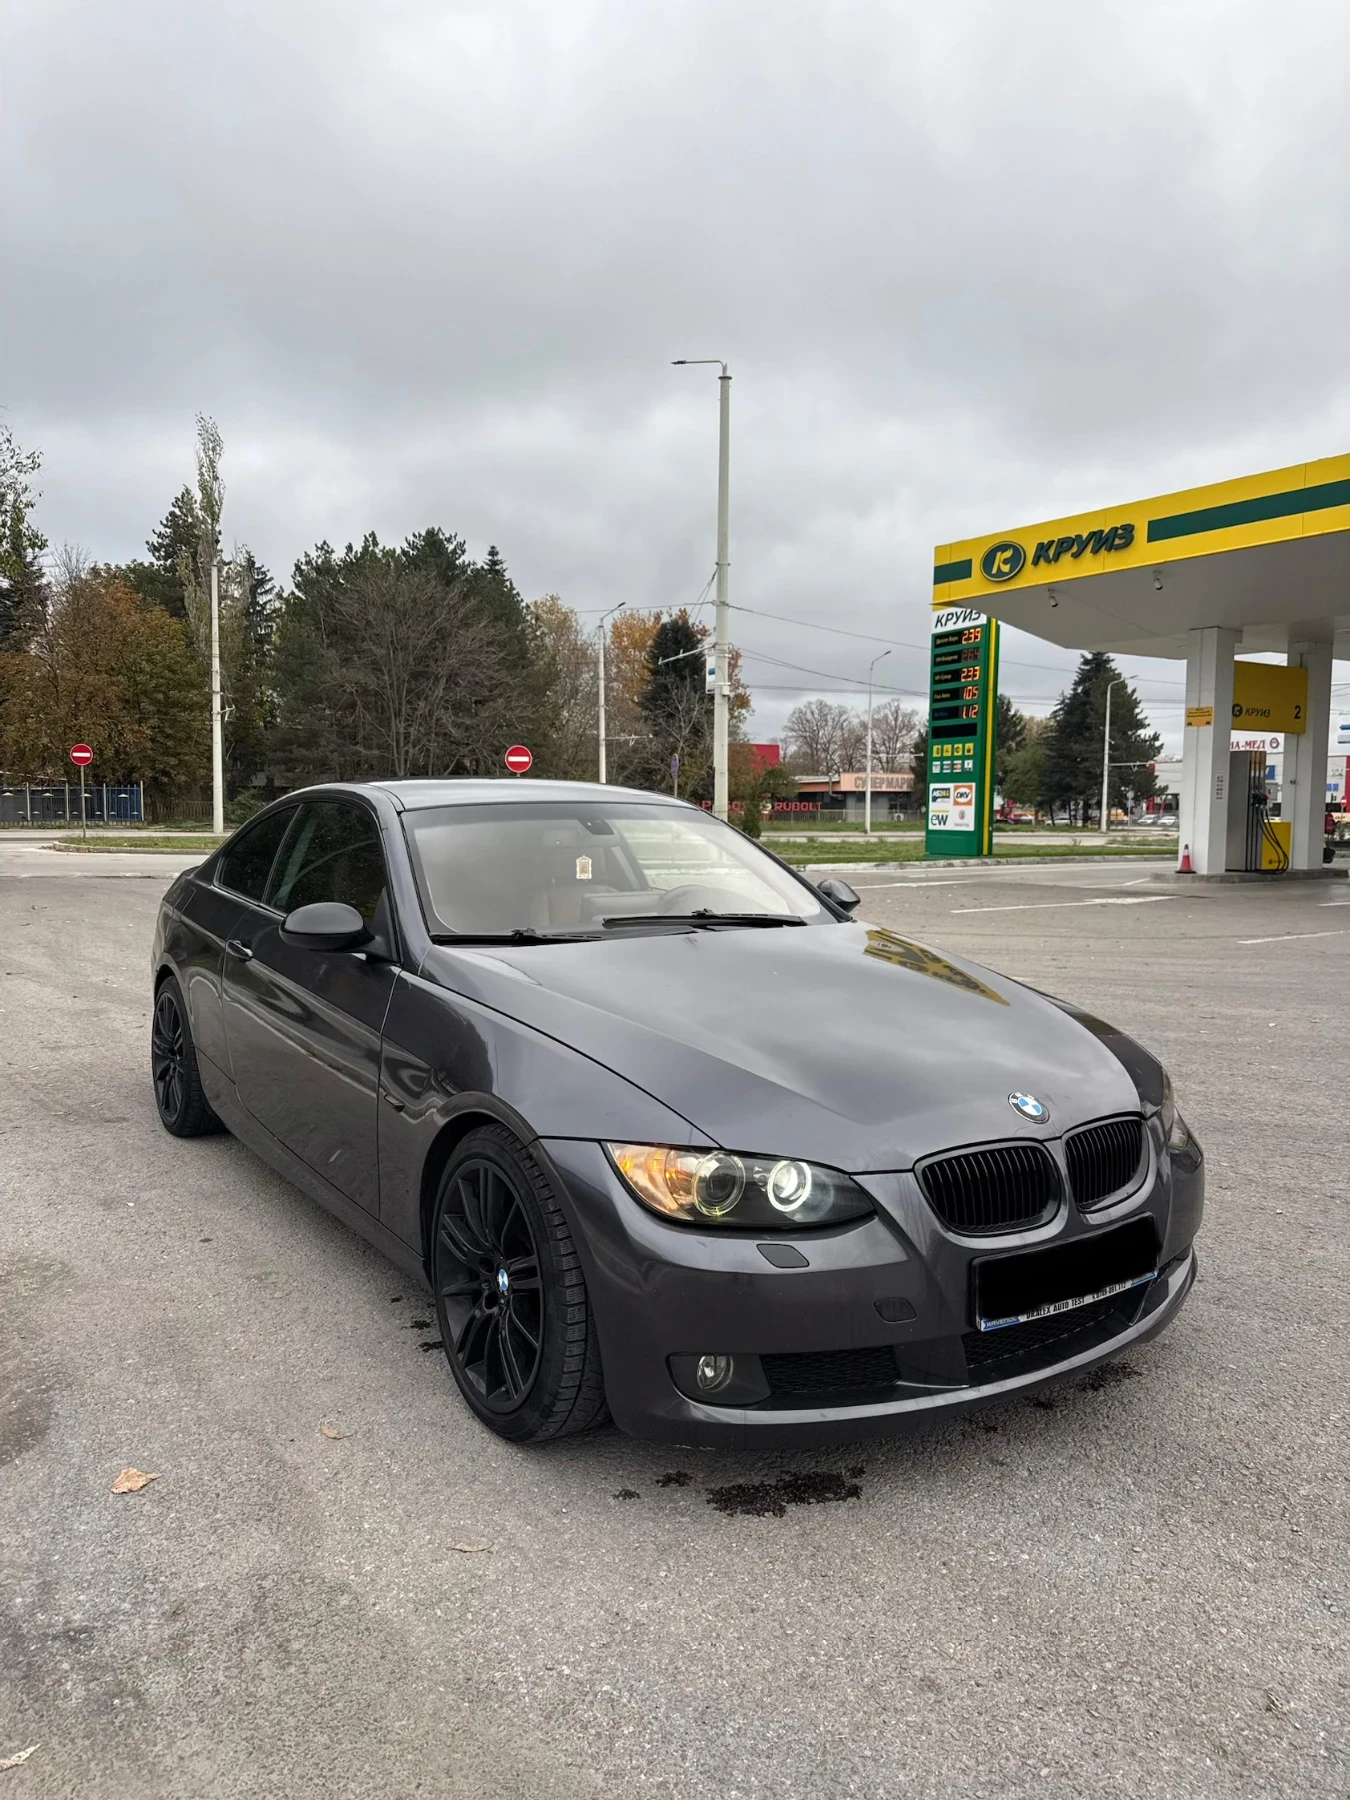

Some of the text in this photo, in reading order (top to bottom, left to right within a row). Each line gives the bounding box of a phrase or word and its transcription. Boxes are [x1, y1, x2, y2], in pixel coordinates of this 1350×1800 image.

[1031, 523, 1135, 566] КРУИЗ
[935, 609, 981, 628] КРУИЗ
[1244, 707, 1271, 718] КРУИЗ
[1294, 705, 1302, 719] 2
[955, 791, 970, 799] DKV
[775, 802, 822, 811] RUBOLT
[1053, 1301, 1069, 1312] AUTO
[1071, 1297, 1085, 1307] TEST
